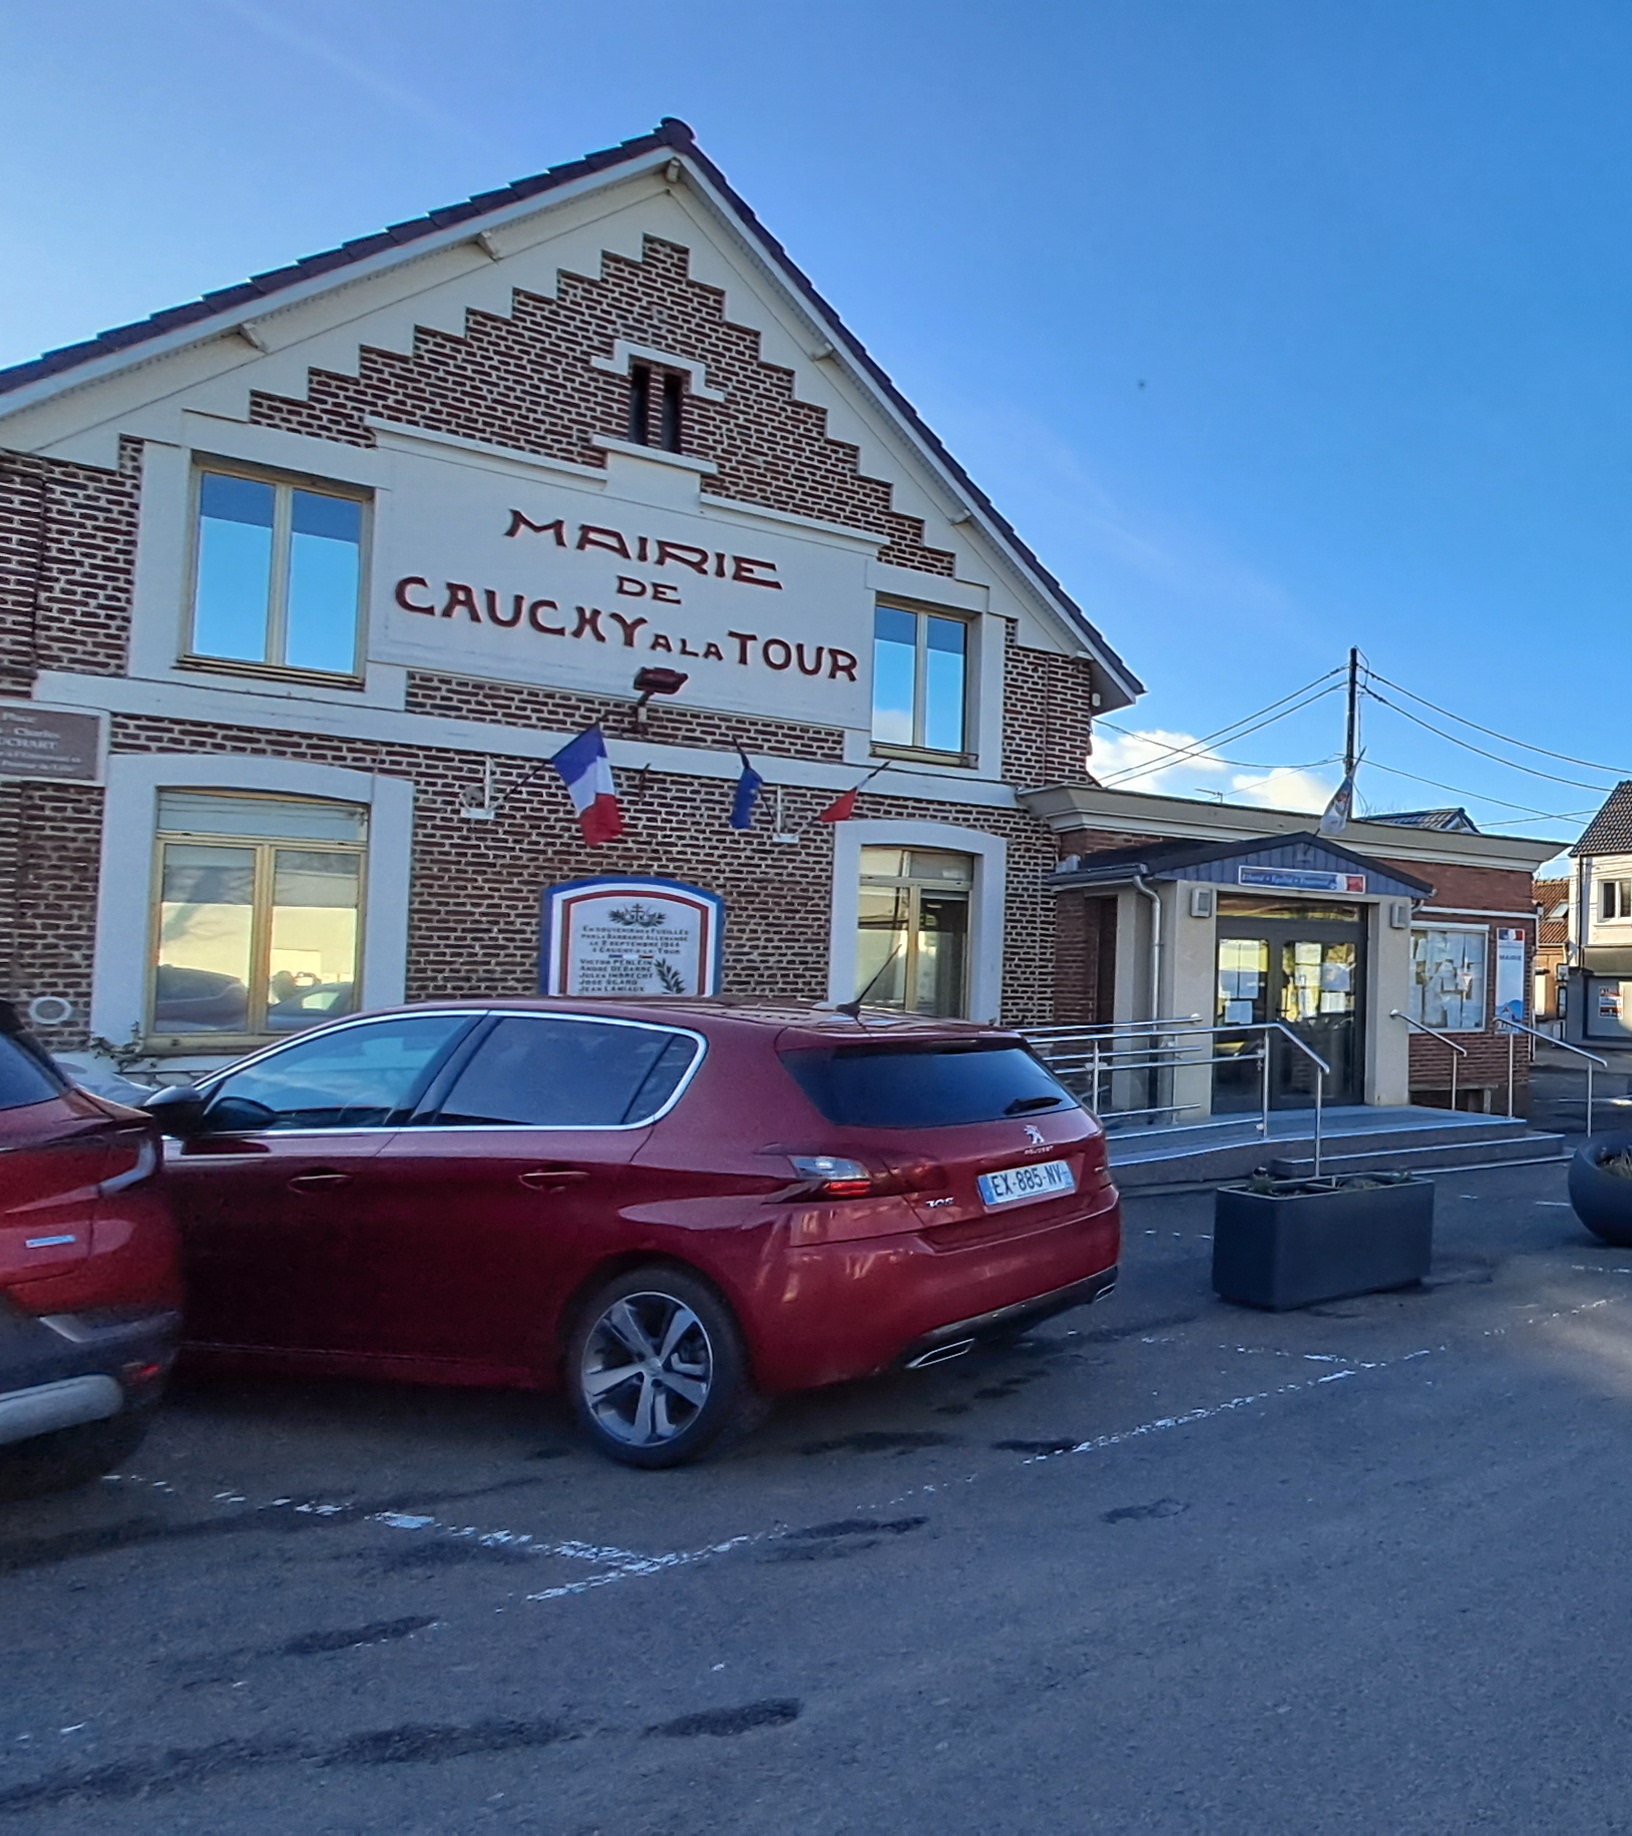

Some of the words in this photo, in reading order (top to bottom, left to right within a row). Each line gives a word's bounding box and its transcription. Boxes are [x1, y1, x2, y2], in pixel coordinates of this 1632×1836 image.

[504, 508, 783, 590] MAIRIE
[616, 575, 682, 605] DE
[394, 576, 648, 648] CAUCHY
[727, 630, 858, 682] TOUR
